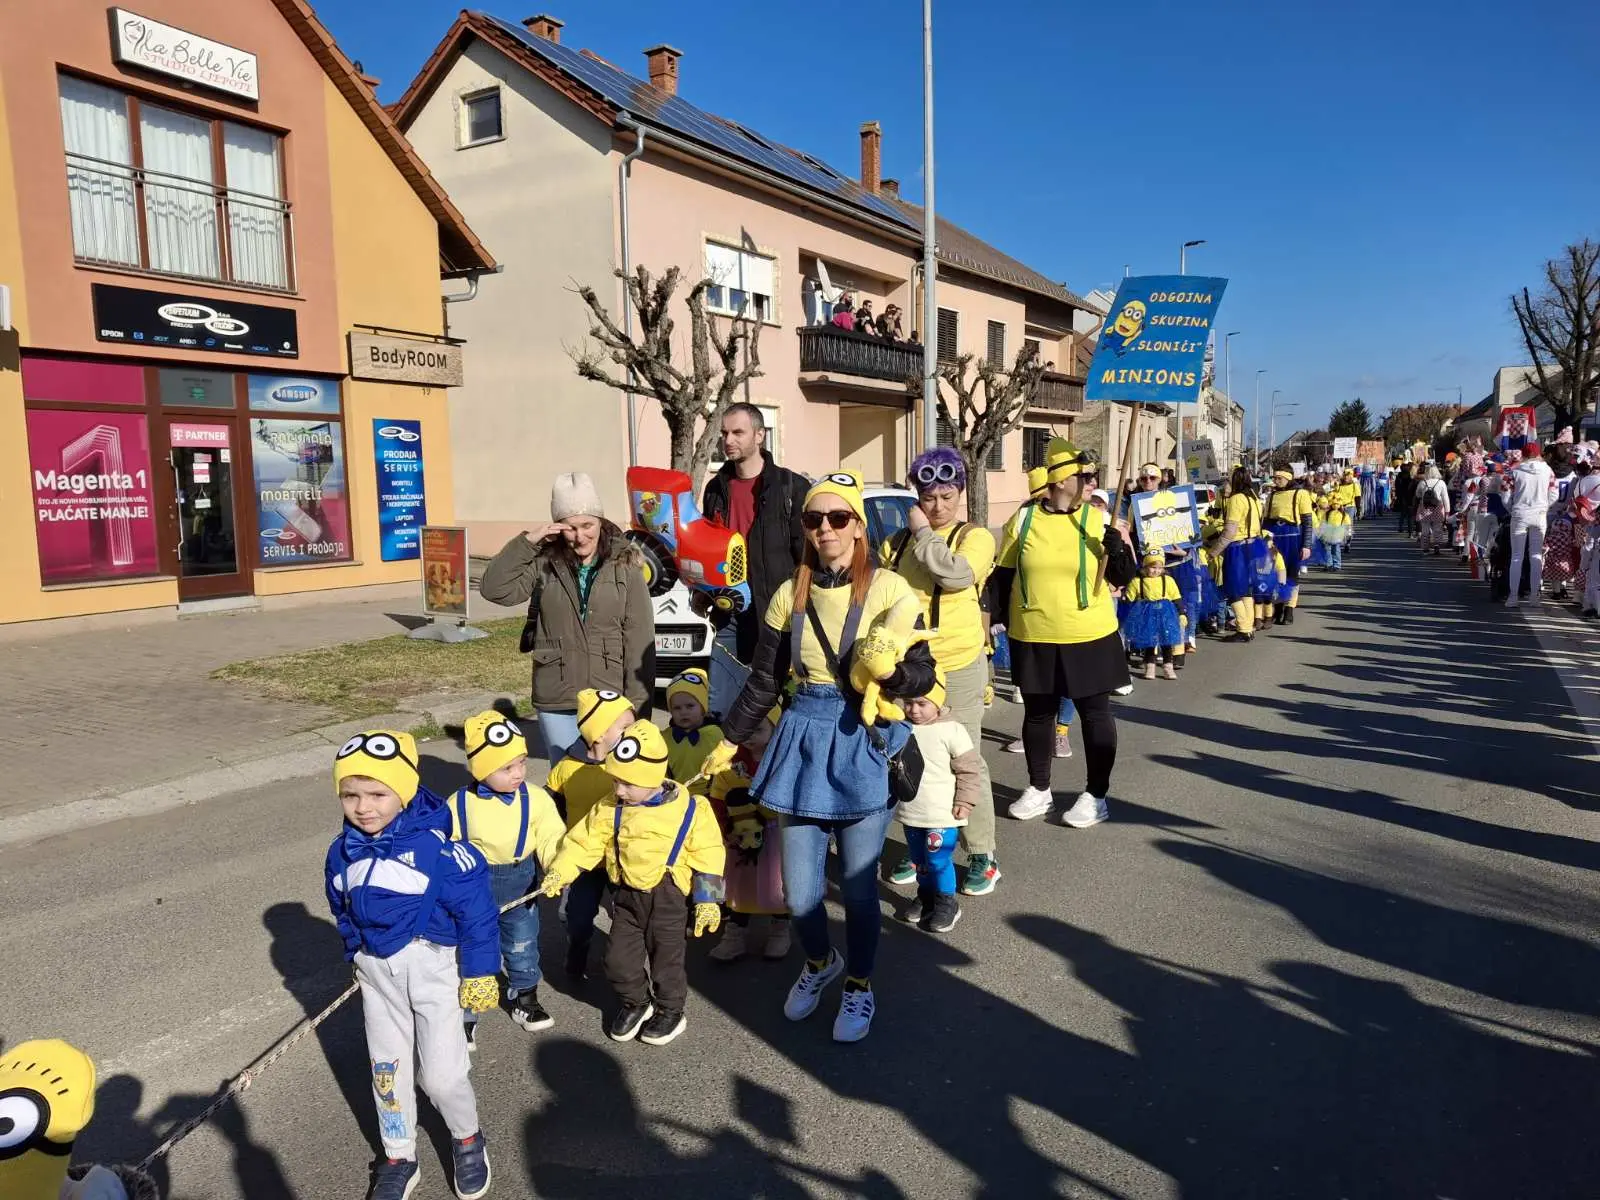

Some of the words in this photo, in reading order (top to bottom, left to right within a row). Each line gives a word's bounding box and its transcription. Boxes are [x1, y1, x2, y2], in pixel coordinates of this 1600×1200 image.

[143, 52, 196, 75] STUDIO
[171, 39, 222, 72] Belle
[226, 57, 252, 82] Vie
[1150, 292, 1212, 304] ODGOJNA
[1150, 315, 1208, 328] SKUPINA
[101, 329, 124, 338] EPSON
[370, 346, 448, 369] BodyROOM
[1101, 369, 1196, 387] MINIONS
[185, 431, 226, 441] PARTNER
[383, 450, 417, 459] PRODAJA
[384, 463, 418, 473] SERVIS
[34, 469, 133, 494] Magenta
[136, 469, 147, 489] 1
[38, 504, 98, 521] PLAĆATE
[100, 506, 149, 519] MANJE!
[263, 545, 296, 558] SERVIS
[299, 544, 305, 555] I
[307, 541, 344, 556] PRODAJA
